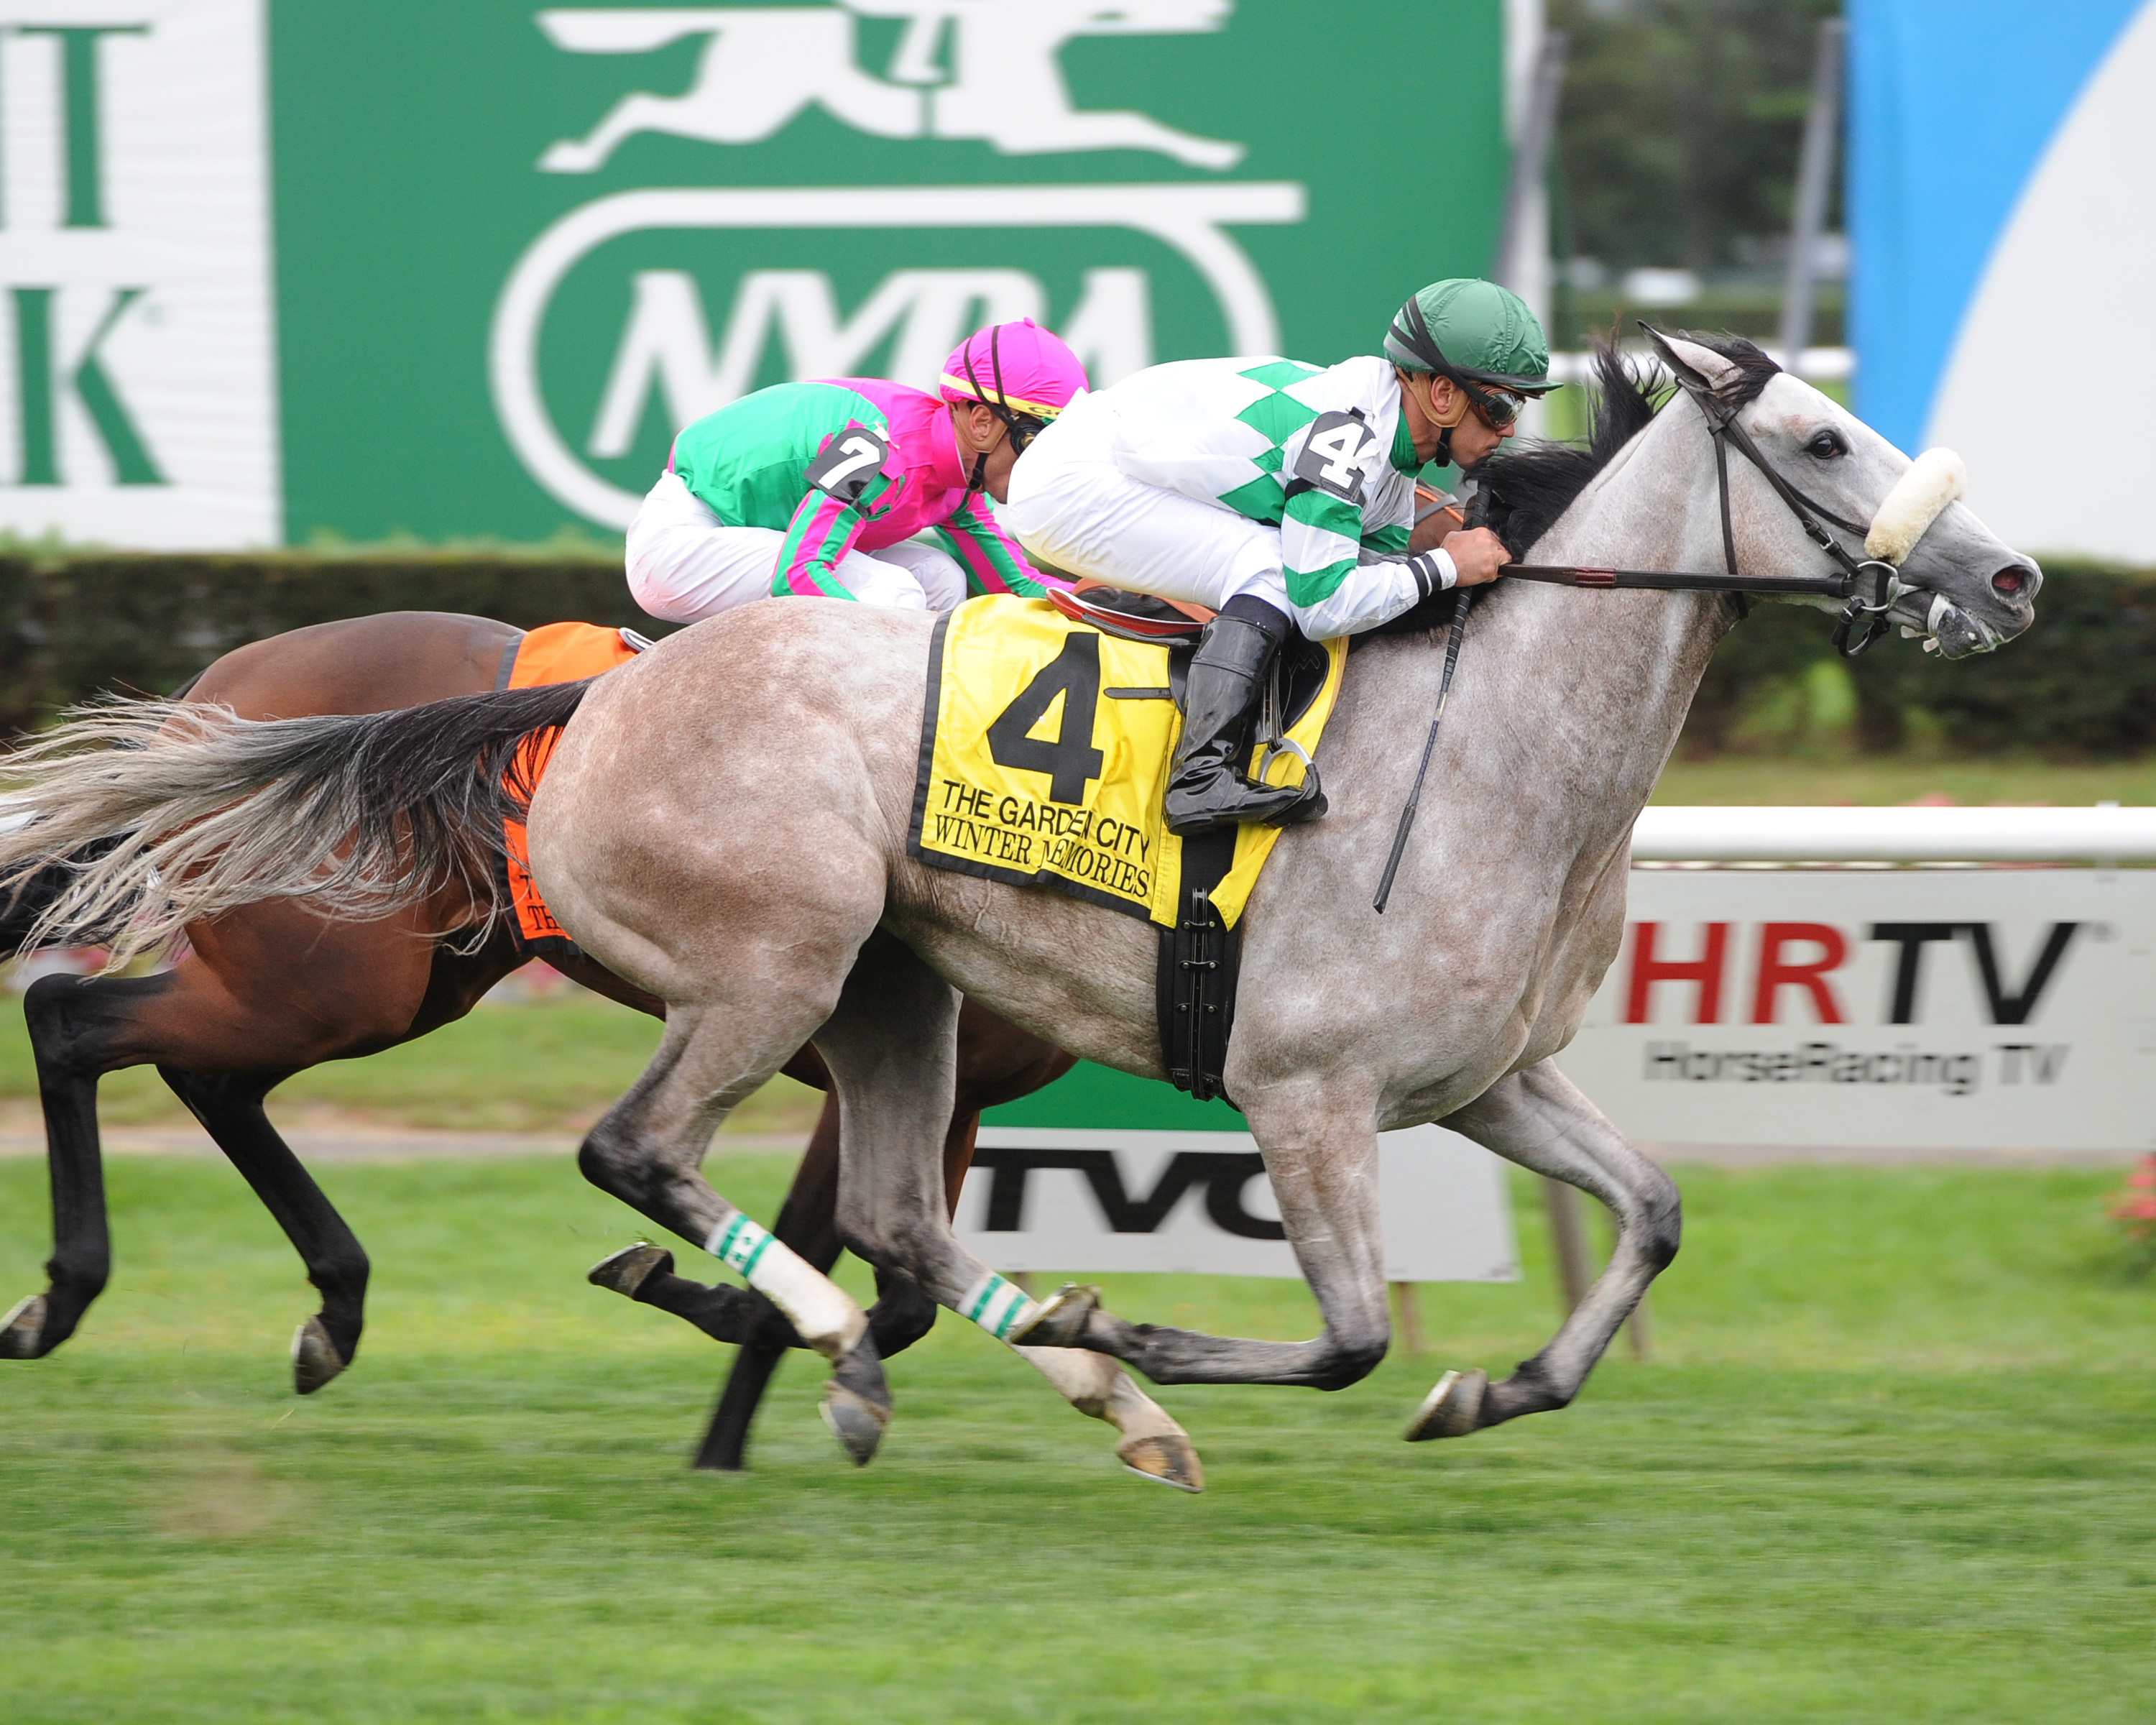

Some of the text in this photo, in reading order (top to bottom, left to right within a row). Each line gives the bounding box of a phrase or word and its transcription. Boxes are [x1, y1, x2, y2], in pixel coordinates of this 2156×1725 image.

[0, 22, 151, 230] T
[0, 286, 174, 487] K
[818, 436, 880, 490] 7
[1309, 422, 1365, 489] 4
[987, 632, 1104, 806] 4
[936, 813, 1151, 898] WINTER MEMORIES
[943, 779, 1150, 863] THE GARDEN CITY
[1618, 921, 2084, 1025] HRTV
[1644, 1041, 2070, 1095] HorseRacing TV
